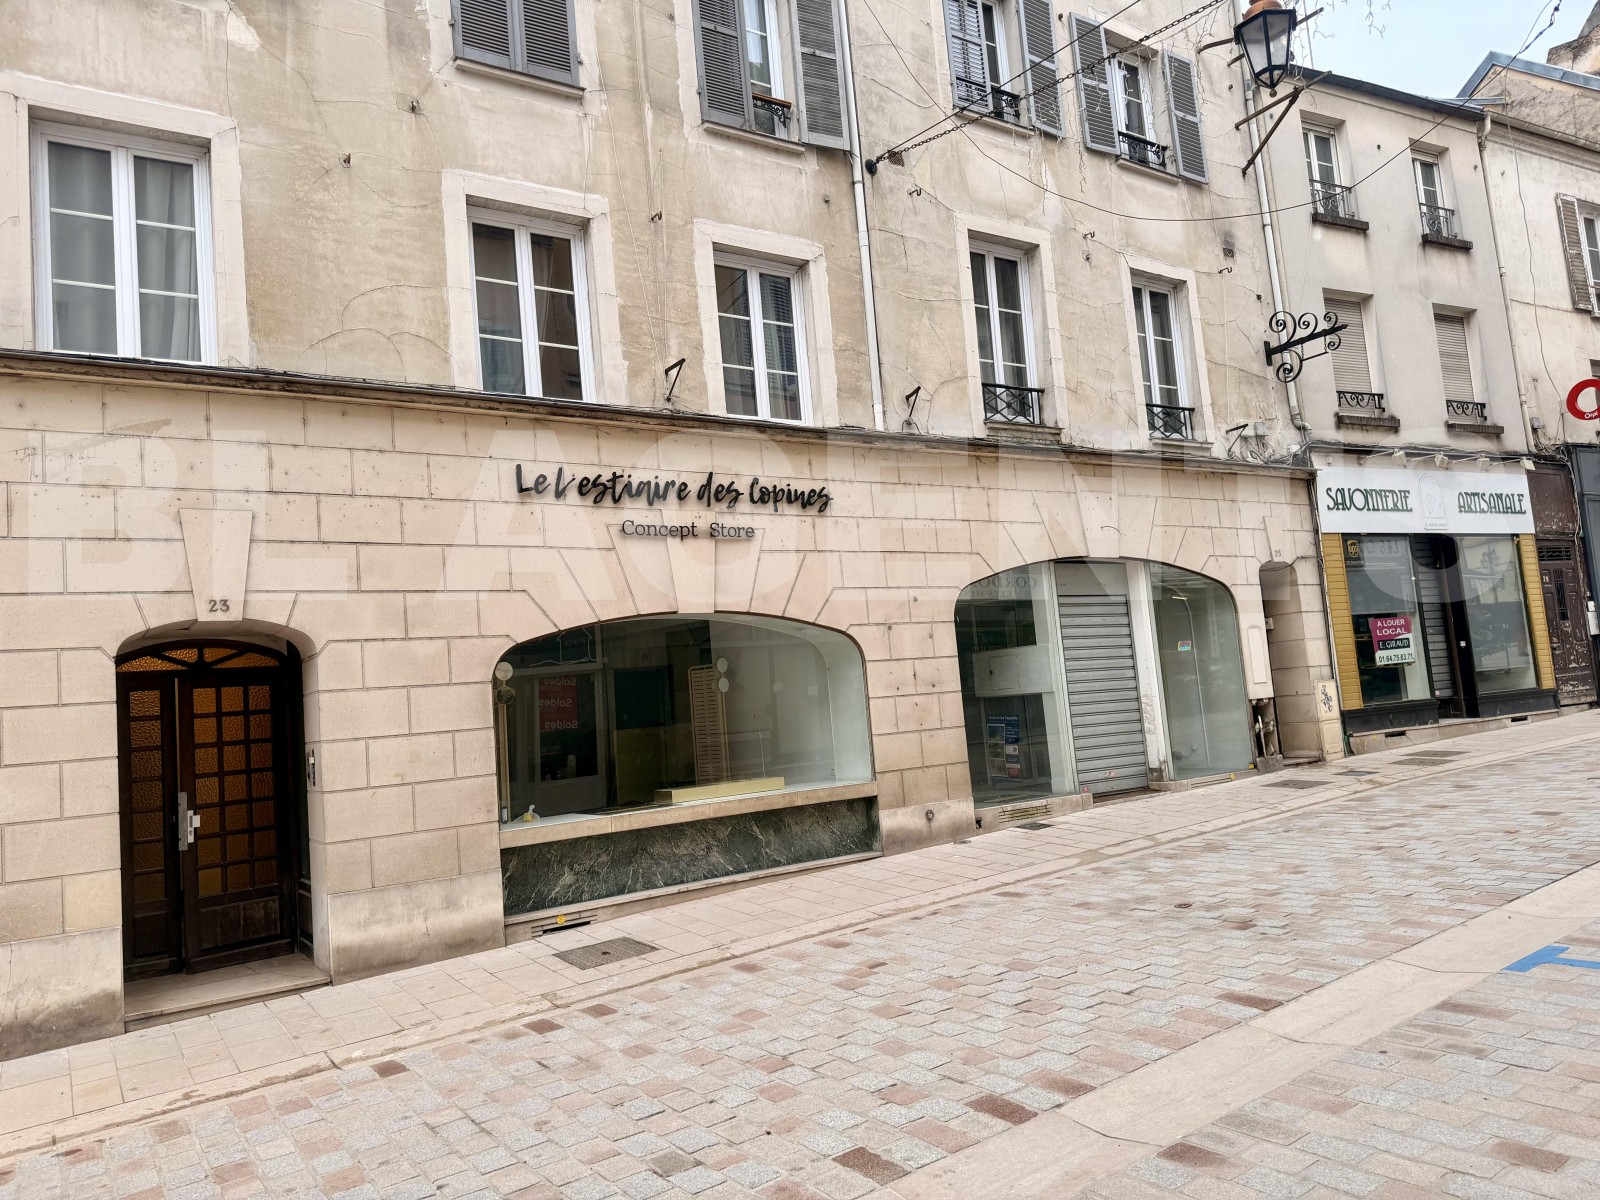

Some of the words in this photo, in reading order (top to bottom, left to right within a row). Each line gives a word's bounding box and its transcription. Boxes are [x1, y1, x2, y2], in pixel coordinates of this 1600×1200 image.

[515, 463, 551, 495] Le
[554, 466, 691, 507] Vestiaire
[696, 471, 744, 509] des
[749, 476, 834, 513] Copines
[1325, 487, 1413, 512] SAVONNERIE
[1457, 491, 1527, 515] ARTISANALE
[621, 519, 698, 542] Concept
[709, 522, 755, 538] Store
[208, 599, 230, 613] 23
[1383, 619, 1405, 627] LOUER
[1377, 628, 1407, 636] LOCAL
[1385, 640, 1409, 649] GIRAUD
